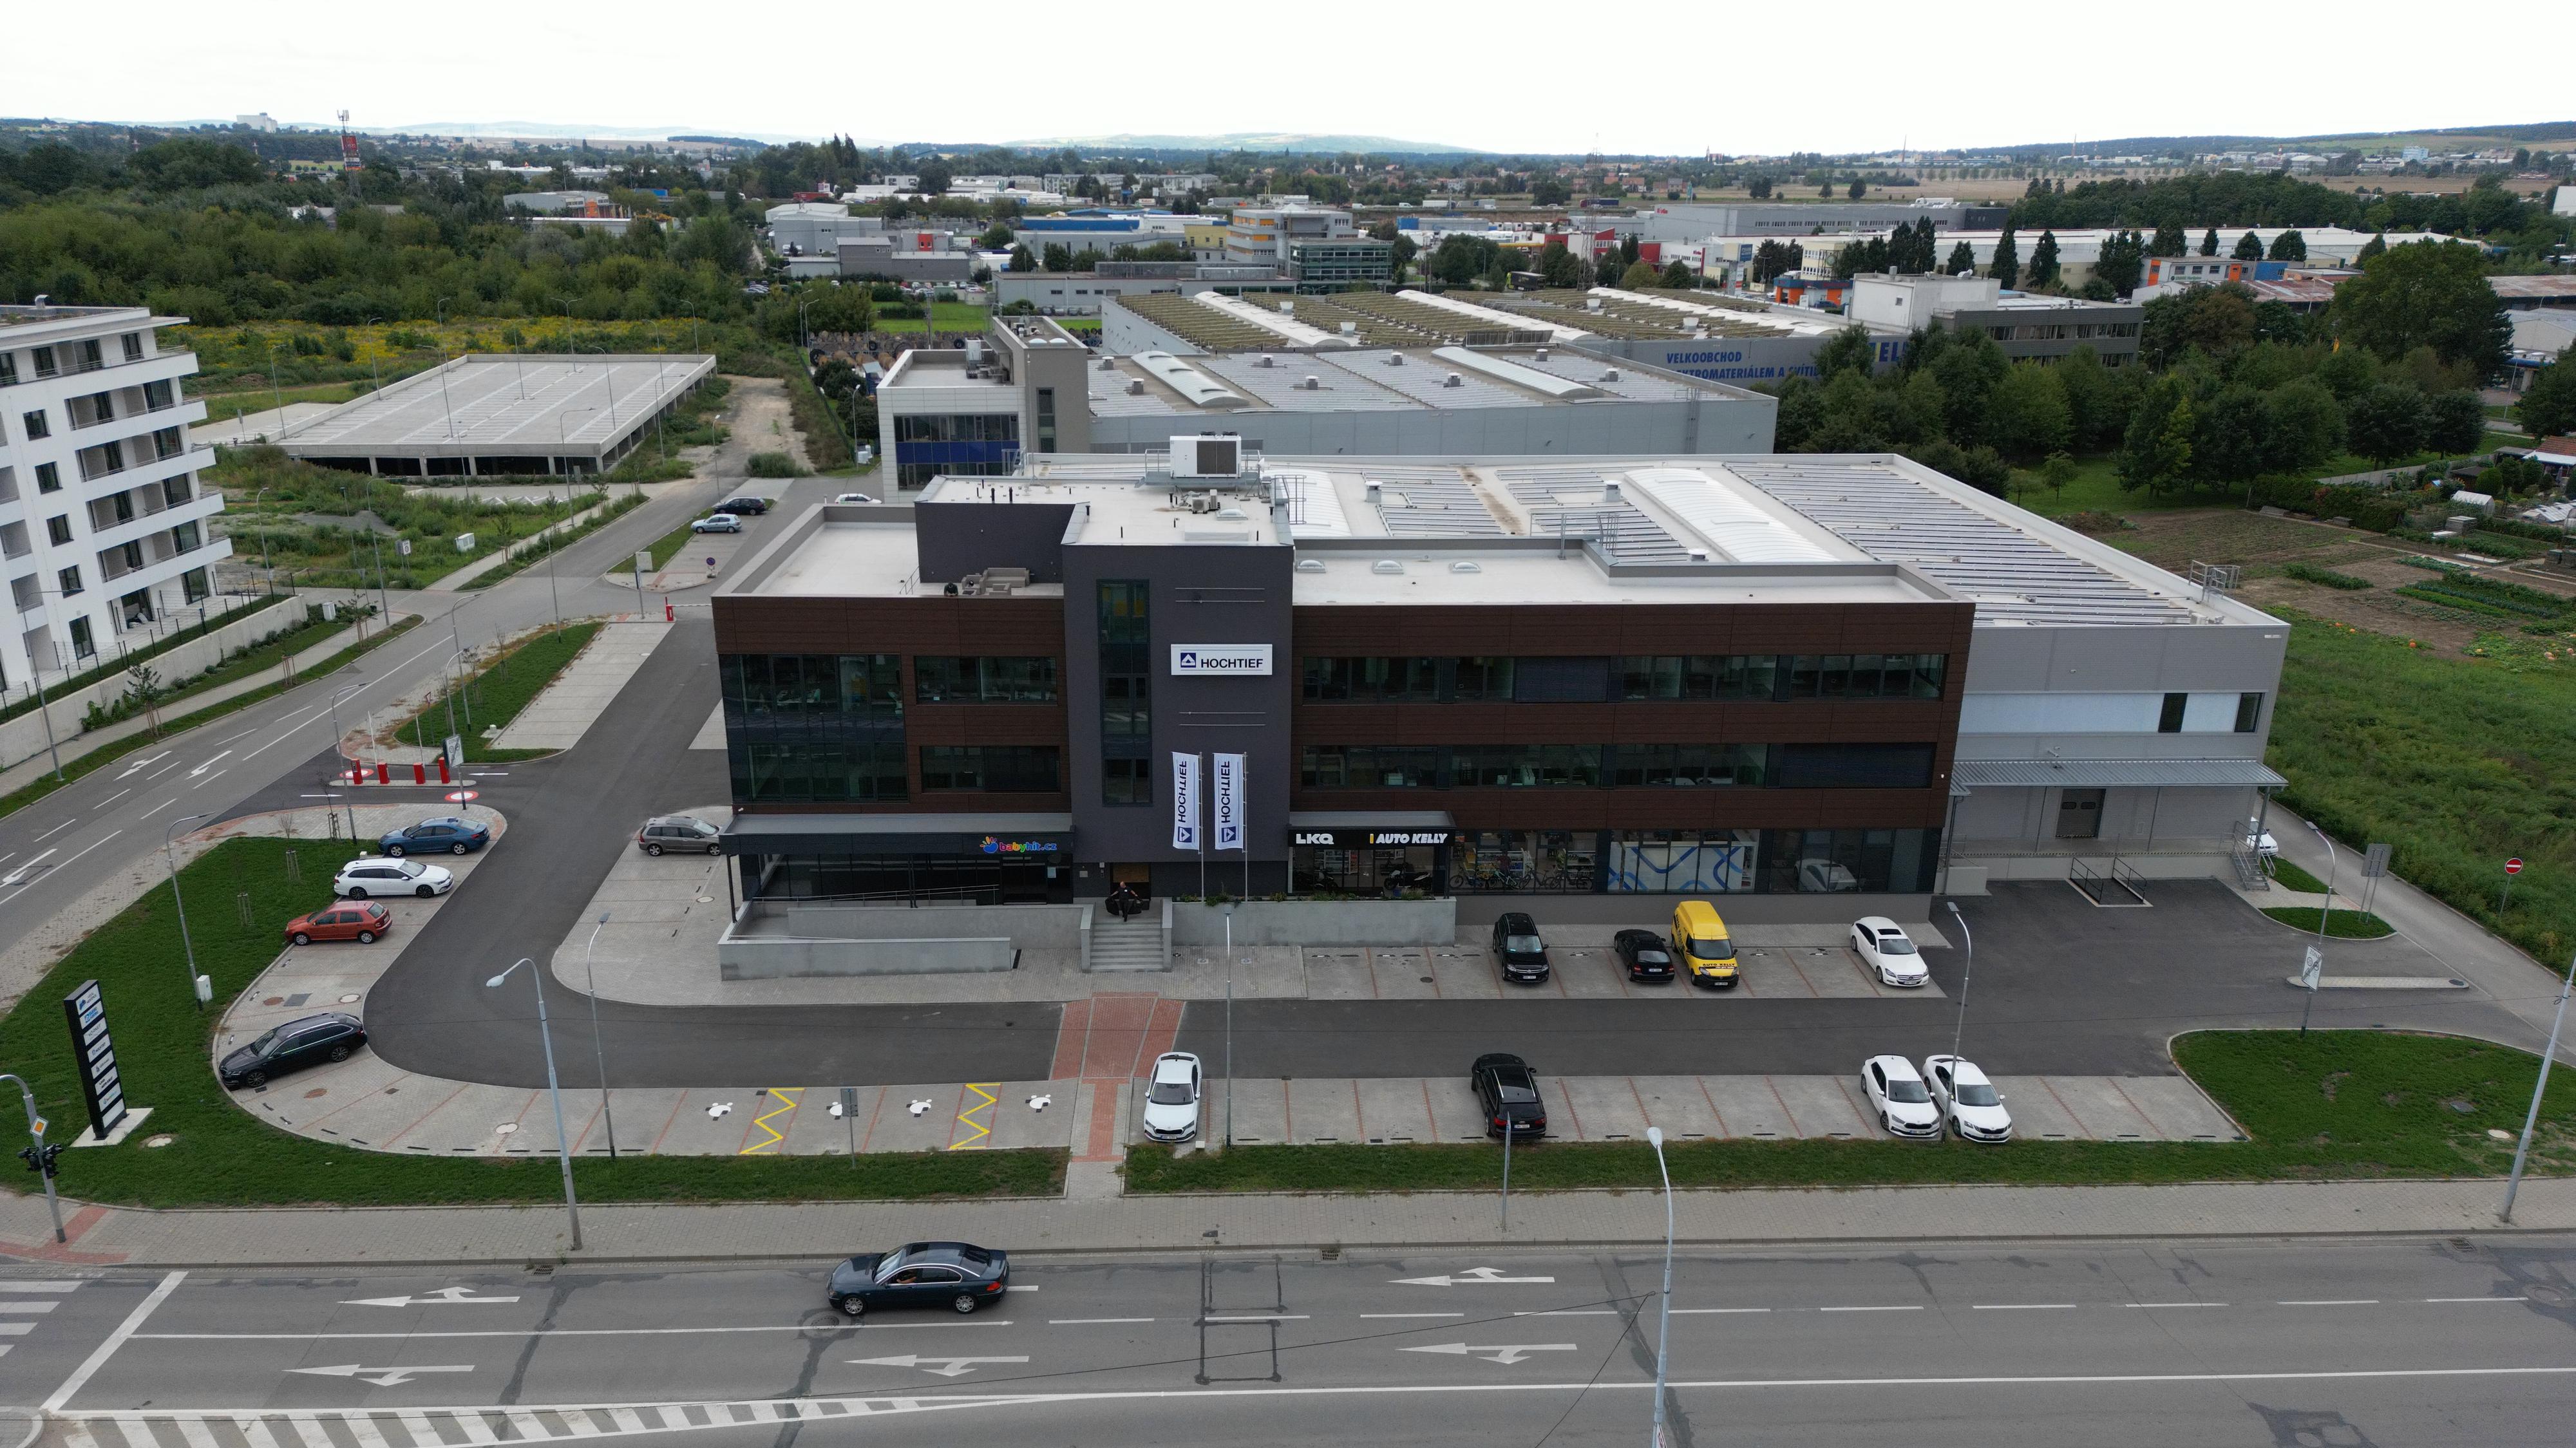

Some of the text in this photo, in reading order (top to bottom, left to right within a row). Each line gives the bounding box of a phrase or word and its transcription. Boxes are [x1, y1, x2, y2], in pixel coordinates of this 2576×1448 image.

[1667, 352, 1742, 364] VELKOOBCHOD
[1676, 364, 1774, 380] TROMATERIÁLEM
[1777, 367, 1785, 377] A
[1200, 659, 1264, 668] HOCHTIEF
[1296, 833, 1334, 845] LKQ
[1375, 833, 1448, 844] AUTO KELLY
[999, 841, 1057, 853] babyhit.cz
